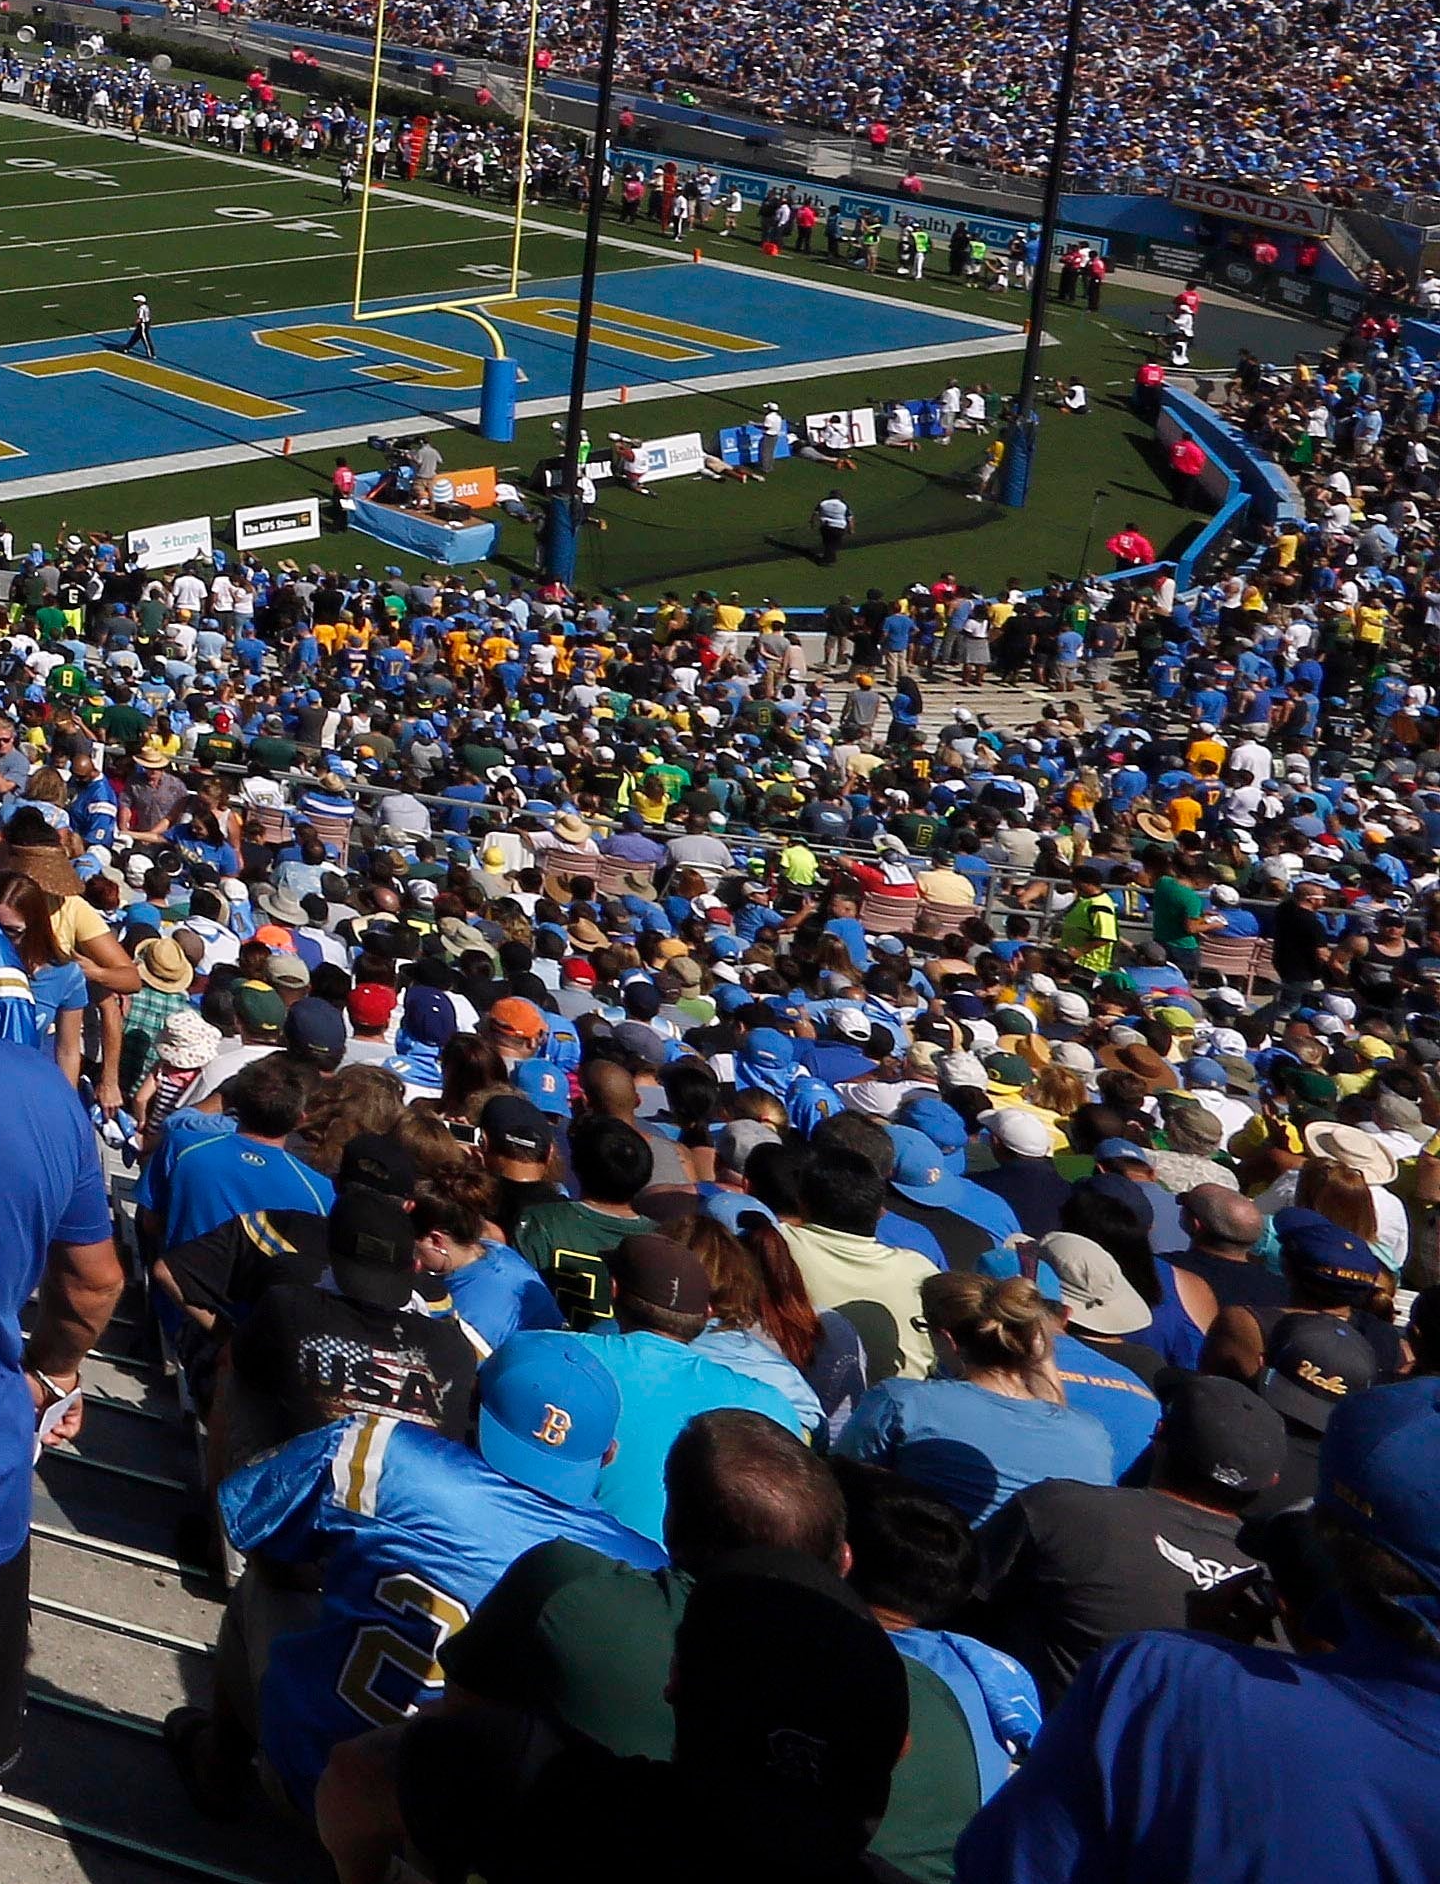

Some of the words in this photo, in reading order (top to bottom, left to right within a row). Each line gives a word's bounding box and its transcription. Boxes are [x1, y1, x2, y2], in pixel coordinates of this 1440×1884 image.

[724, 178, 761, 195] UCLA
[1179, 181, 1318, 230] HONDA
[669, 447, 701, 465] Health
[244, 522, 258, 535] The
[259, 520, 275, 533] UPS
[276, 518, 297, 530] Store
[172, 530, 209, 546] tunein
[62, 669, 74, 688] 8
[301, 1351, 435, 1412] USA
[531, 1403, 573, 1447] B
[335, 1572, 471, 1729] 2
